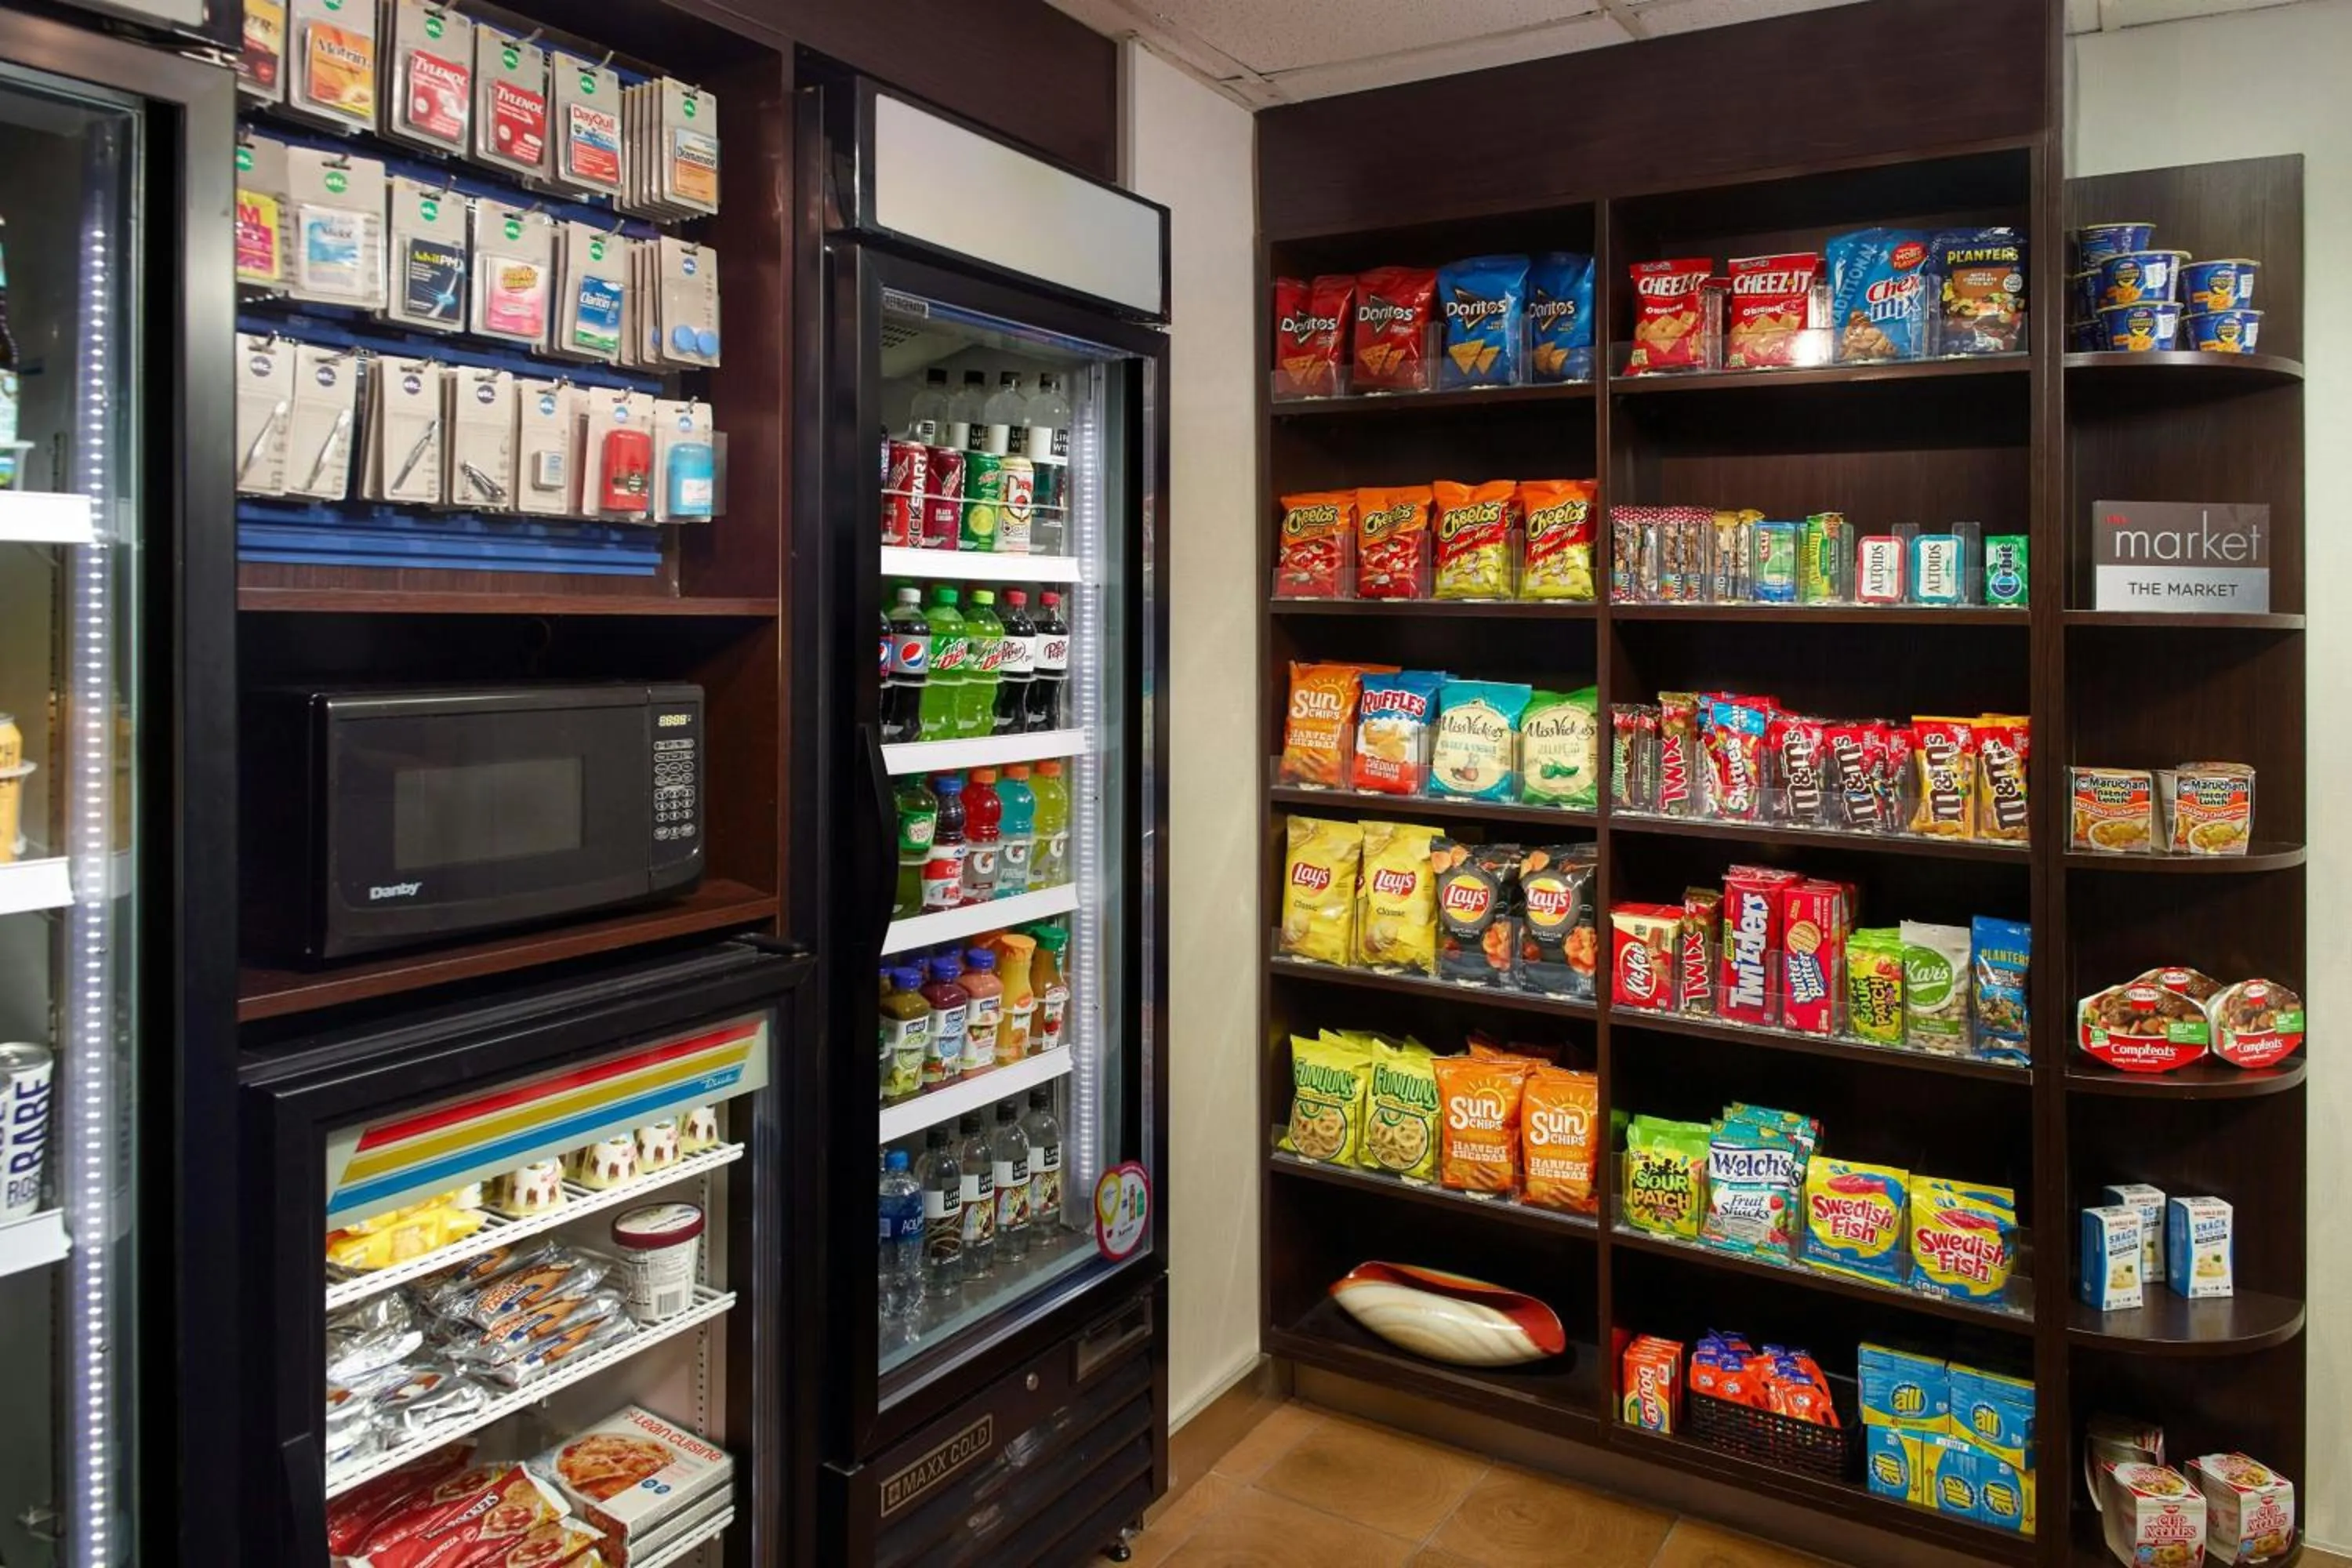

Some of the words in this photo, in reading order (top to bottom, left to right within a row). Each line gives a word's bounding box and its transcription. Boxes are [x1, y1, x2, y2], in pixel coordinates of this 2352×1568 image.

[573, 106, 615, 130] DayQuil
[438, 255, 461, 269] PM
[1946, 246, 2019, 266] PLANTERS
[1733, 271, 1813, 295] CHEEZ-IT
[1866, 274, 1920, 303] Chex
[1358, 306, 1414, 321] Doritos
[1446, 299, 1506, 317] Doritos
[1530, 299, 1575, 318] Doritos
[1868, 293, 1921, 322] mix
[1279, 317, 1338, 332] Doritos
[907, 452, 927, 549] KICKSTART
[1287, 506, 1338, 534] Cheetos
[1365, 504, 1414, 534] Cheetos
[1443, 505, 1499, 539] Cheetos
[1530, 503, 1587, 539] Cheetos
[2115, 510, 2261, 561] market
[1871, 544, 1883, 593] ALTOIDS
[1928, 543, 1943, 593] ALTOIDS
[2128, 583, 2161, 594] THE
[2168, 583, 2238, 597] MARKET
[1291, 689, 1342, 719] Sun
[1308, 708, 1340, 720] CHIPS
[1361, 689, 1427, 717] RUFFLES
[1442, 714, 1467, 735] Miss
[1527, 720, 1555, 738] Miss
[1659, 734, 1689, 812] TWIX
[1727, 738, 1750, 812] Skittles
[2089, 777, 2146, 789] Maruchan
[2191, 779, 2248, 791] Maruchan
[2093, 789, 2132, 797] Instant
[2098, 795, 2128, 804] Lunch
[1294, 864, 1330, 892] Lay's
[1374, 869, 1416, 896] Lay's
[370, 882, 423, 901] Danby
[1446, 885, 1488, 912] Lay's
[1728, 892, 1769, 1008] Twizzlers
[1680, 931, 1711, 1010] TWIX
[1788, 955, 1805, 1003] Nutter
[1799, 950, 1825, 1000] Butter
[1859, 978, 1874, 1024] SOUR
[1871, 977, 1887, 1025] PATCH
[2111, 1043, 2177, 1058] Compleats
[2237, 1037, 2282, 1054] Compleats
[1295, 1060, 1356, 1101] FUNYUNS
[1373, 1063, 1438, 1111] FUNYUNS
[1449, 1096, 1504, 1130] Sun
[1468, 1119, 1504, 1131] CHIPS
[1529, 1109, 1588, 1146] Sun
[1548, 1133, 1586, 1147] CHIPS
[1450, 1149, 1508, 1163] CHEDDAR
[1452, 1141, 1508, 1154] HARVEST
[1529, 1167, 1589, 1181] CHEDDAR
[1530, 1157, 1590, 1172] HARVEST
[1712, 1151, 1795, 1176] Welch's
[7, 1176, 39, 1208] ROS
[1635, 1171, 1689, 1191] SOUR
[1632, 1189, 1693, 1210] PATCH
[1719, 1203, 1770, 1220] Snacks
[1730, 1193, 1764, 1209] Fruit
[1811, 1194, 1896, 1230] Swedish
[1829, 1215, 1878, 1245] Fish
[2108, 1229, 2138, 1244] SNACK
[2195, 1219, 2227, 1233] SNACK
[1916, 1228, 2007, 1267] Swedish
[1936, 1251, 1990, 1283] Fish
[1894, 1388, 1922, 1410] all
[1974, 1410, 1999, 1432] all
[902, 1455, 947, 1496] MAXX
[949, 1426, 988, 1465] COLD
[1875, 1453, 1902, 1486] all
[1943, 1475, 1972, 1508] all
[1985, 1482, 2016, 1516] all
[2144, 1526, 2196, 1539] NOODLES
[2158, 1515, 2187, 1528] CUP
